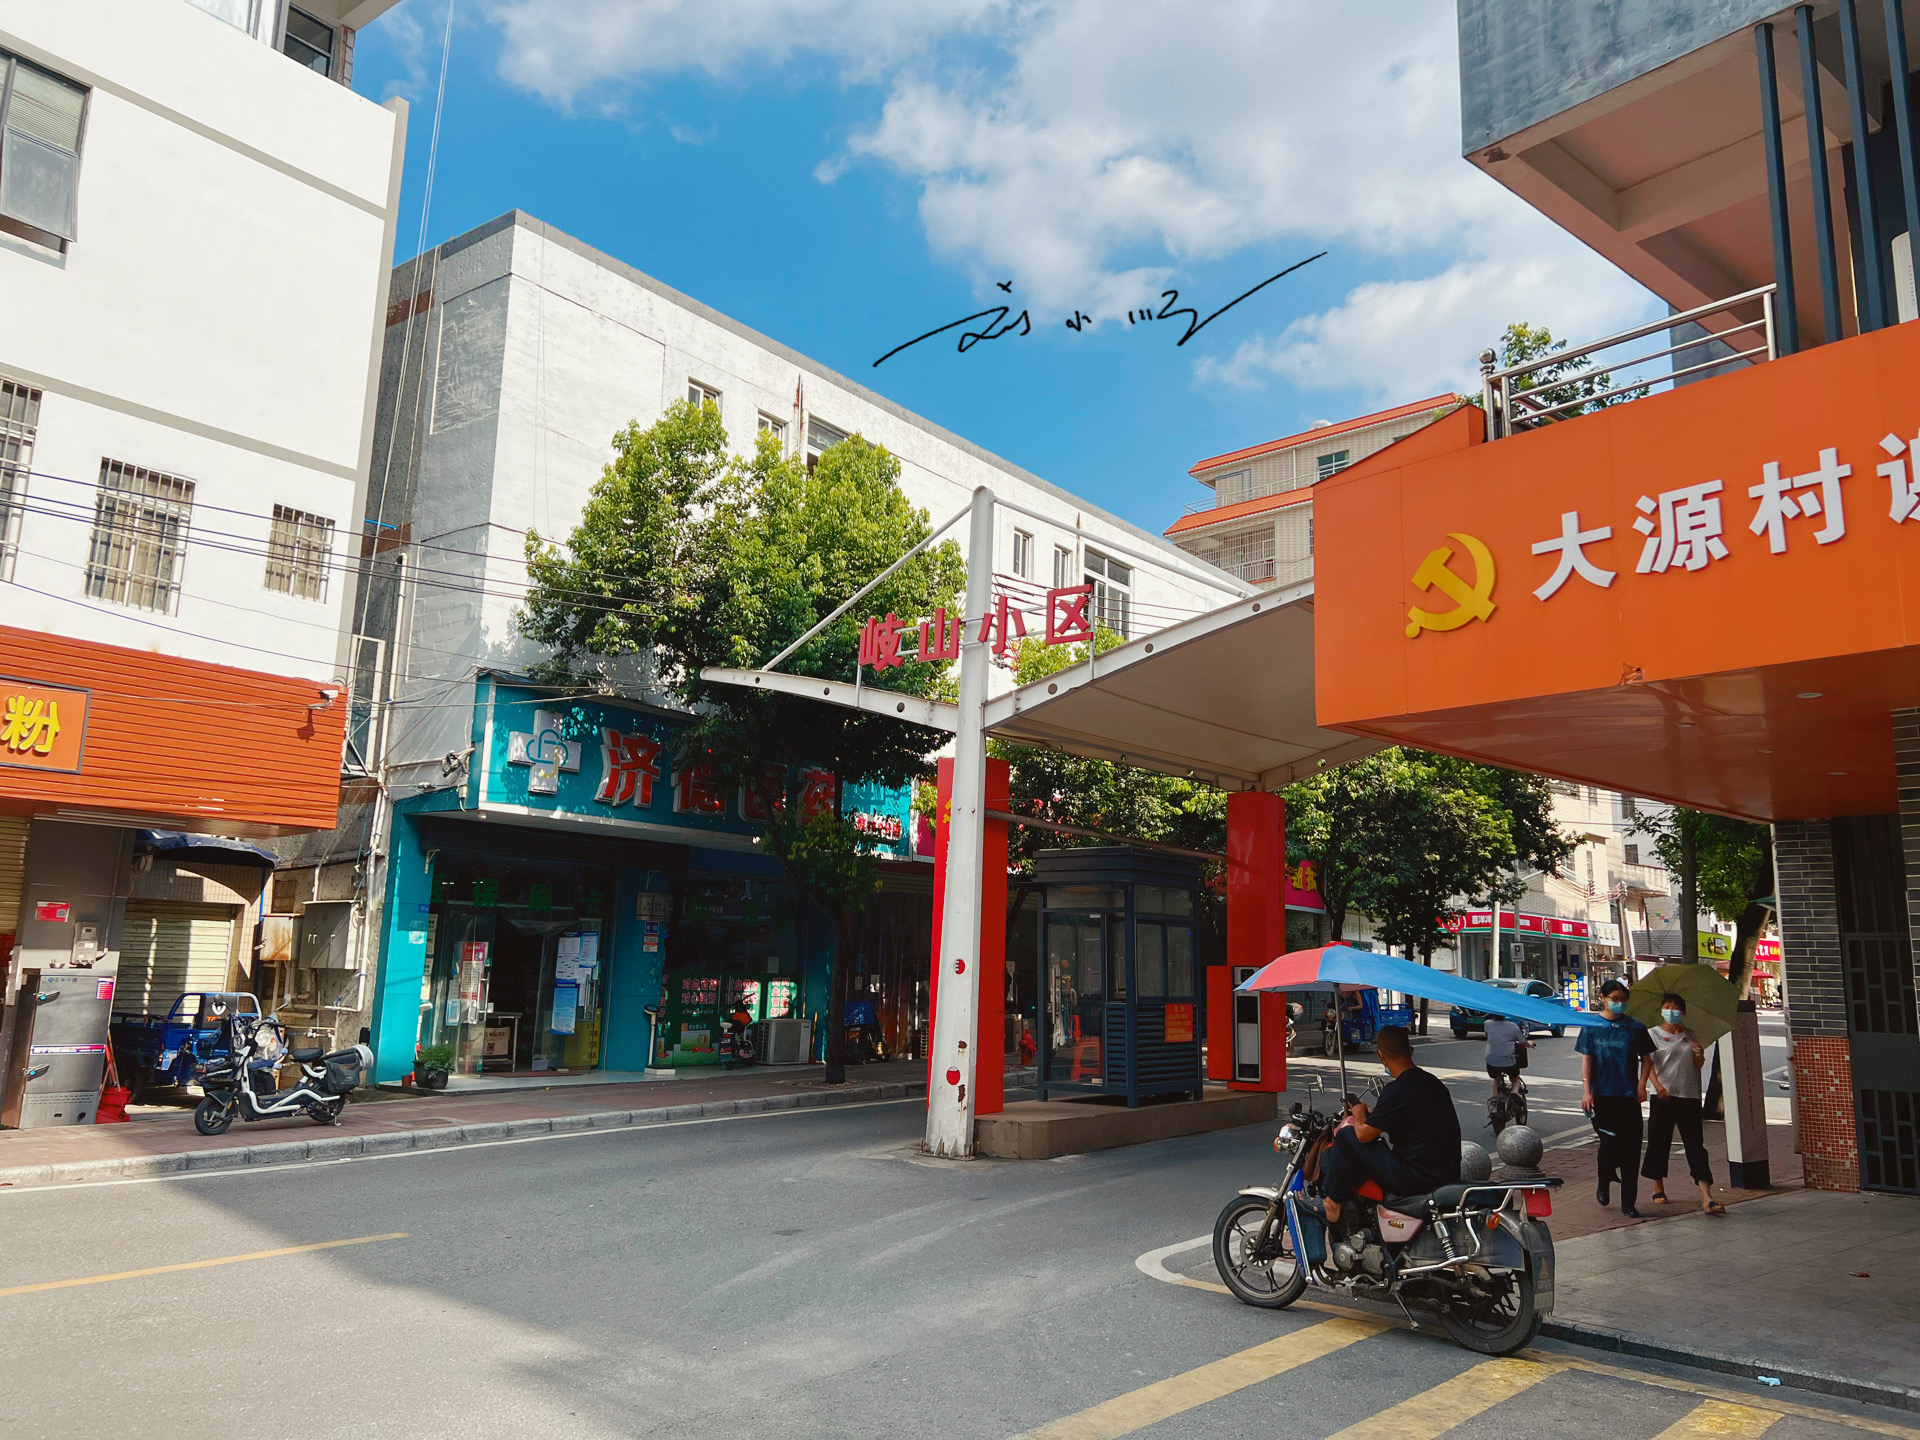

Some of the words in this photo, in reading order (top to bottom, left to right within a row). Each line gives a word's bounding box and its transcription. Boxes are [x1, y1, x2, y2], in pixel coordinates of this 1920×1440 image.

[859, 584, 1094, 672] 岐山小区
[1, 694, 61, 753] 粉
[1515, 944, 1521, 956] P
